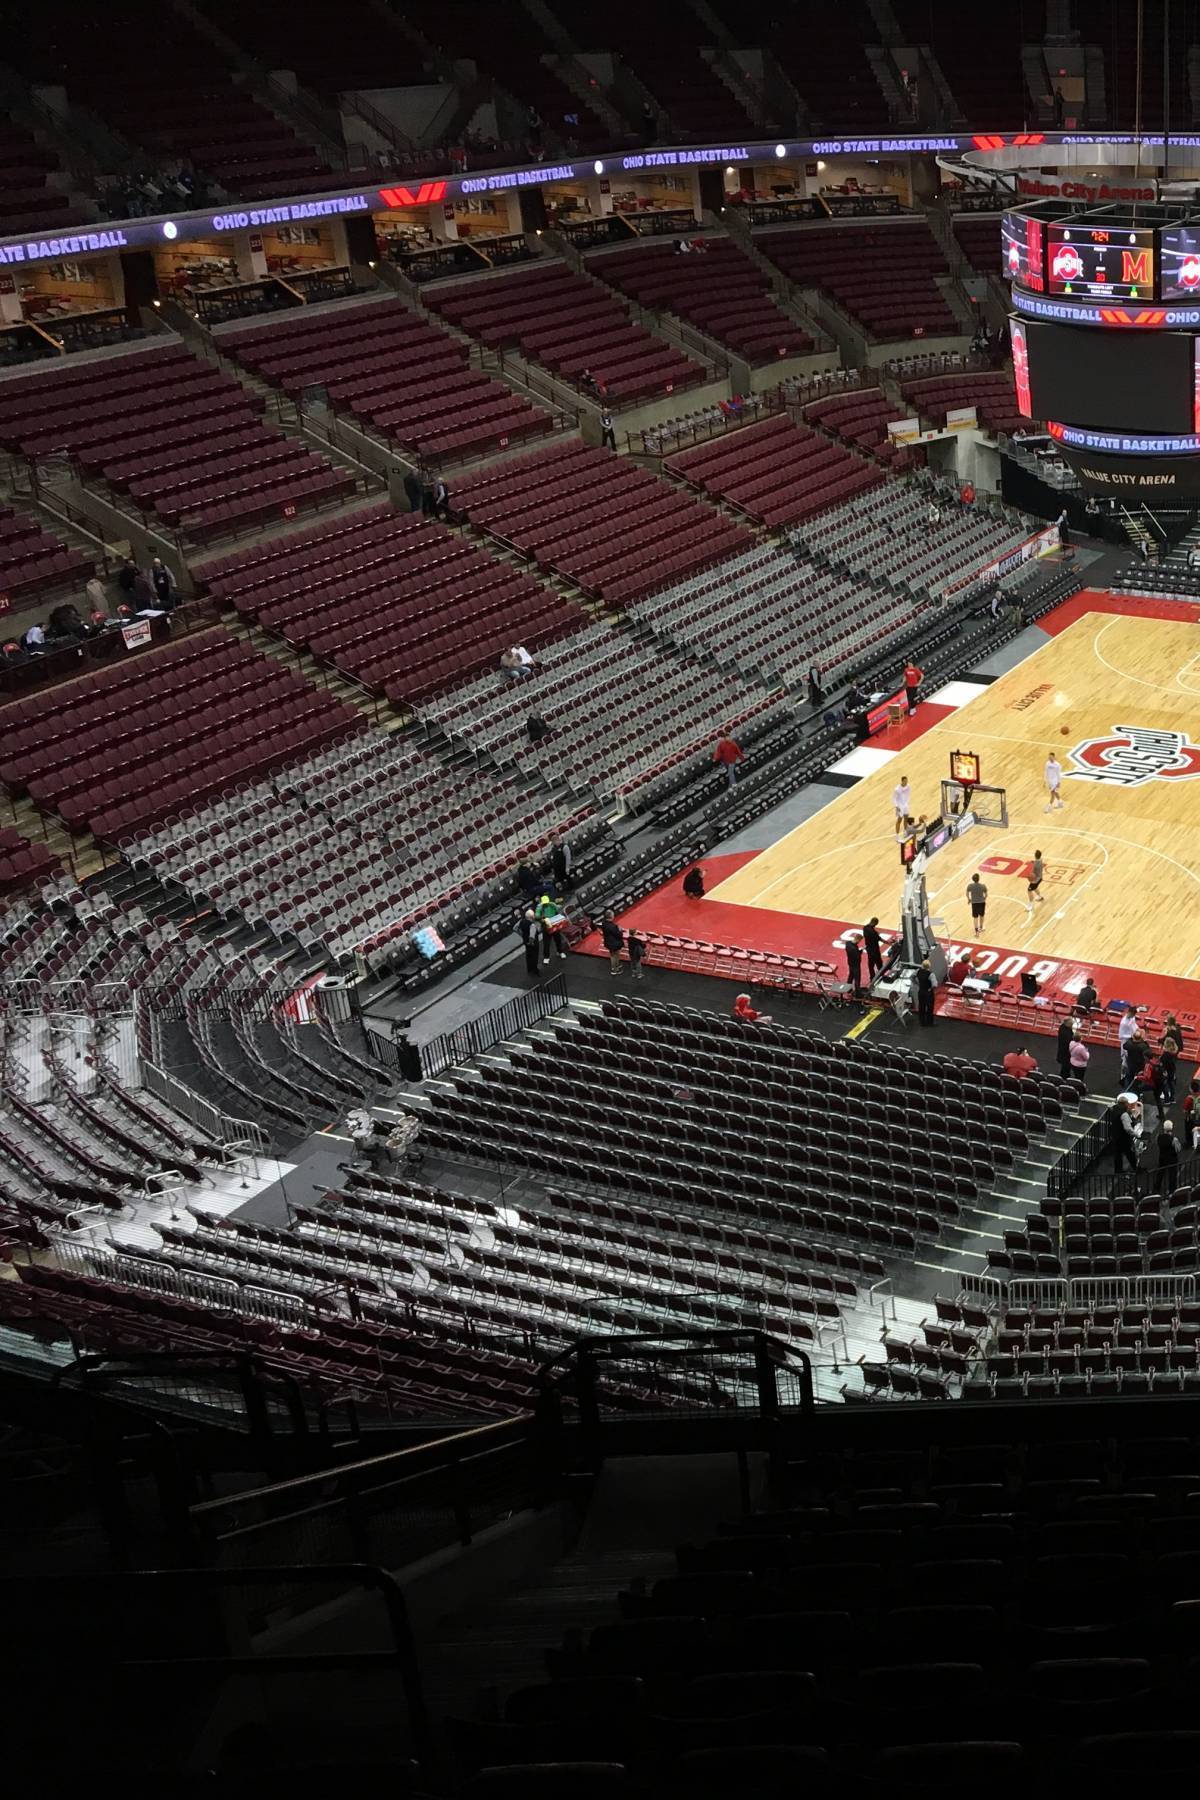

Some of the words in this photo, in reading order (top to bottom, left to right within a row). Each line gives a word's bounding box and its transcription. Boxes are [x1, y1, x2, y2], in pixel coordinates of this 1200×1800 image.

[813, 143, 842, 154] OHIO
[843, 140, 879, 152] STATE
[881, 138, 958, 152] BASKETBALL
[623, 156, 644, 169] OHIO
[645, 153, 677, 166] STATE
[679, 148, 749, 164] BASKETBALL
[461, 177, 487, 193] OHIO
[488, 173, 517, 190] STATE
[518, 166, 574, 186] BASKETBALL
[1017, 178, 1060, 197] Value
[1061, 182, 1098, 203] City
[1099, 184, 1155, 200] Arena
[212, 211, 249, 231] OHIO
[250, 206, 290, 226] STATE
[292, 195, 368, 219] BASKETBALL
[26, 230, 127, 259] BASKETBALL
[1091, 231, 1109, 242] 7:24
[1121, 251, 1149, 283] M
[1036, 300, 1102, 322] BASKETBALL
[1165, 311, 1200, 324] OHIO
[1063, 430, 1085, 445] OHIO
[1086, 435, 1120, 449] STATE
[1081, 467, 1111, 483] VALUE
[1112, 474, 1136, 485] CITY
[1139, 474, 1176, 485] ARENA
[956, 765, 975, 779] 30
[1181, 1013, 1197, 1021] 10
